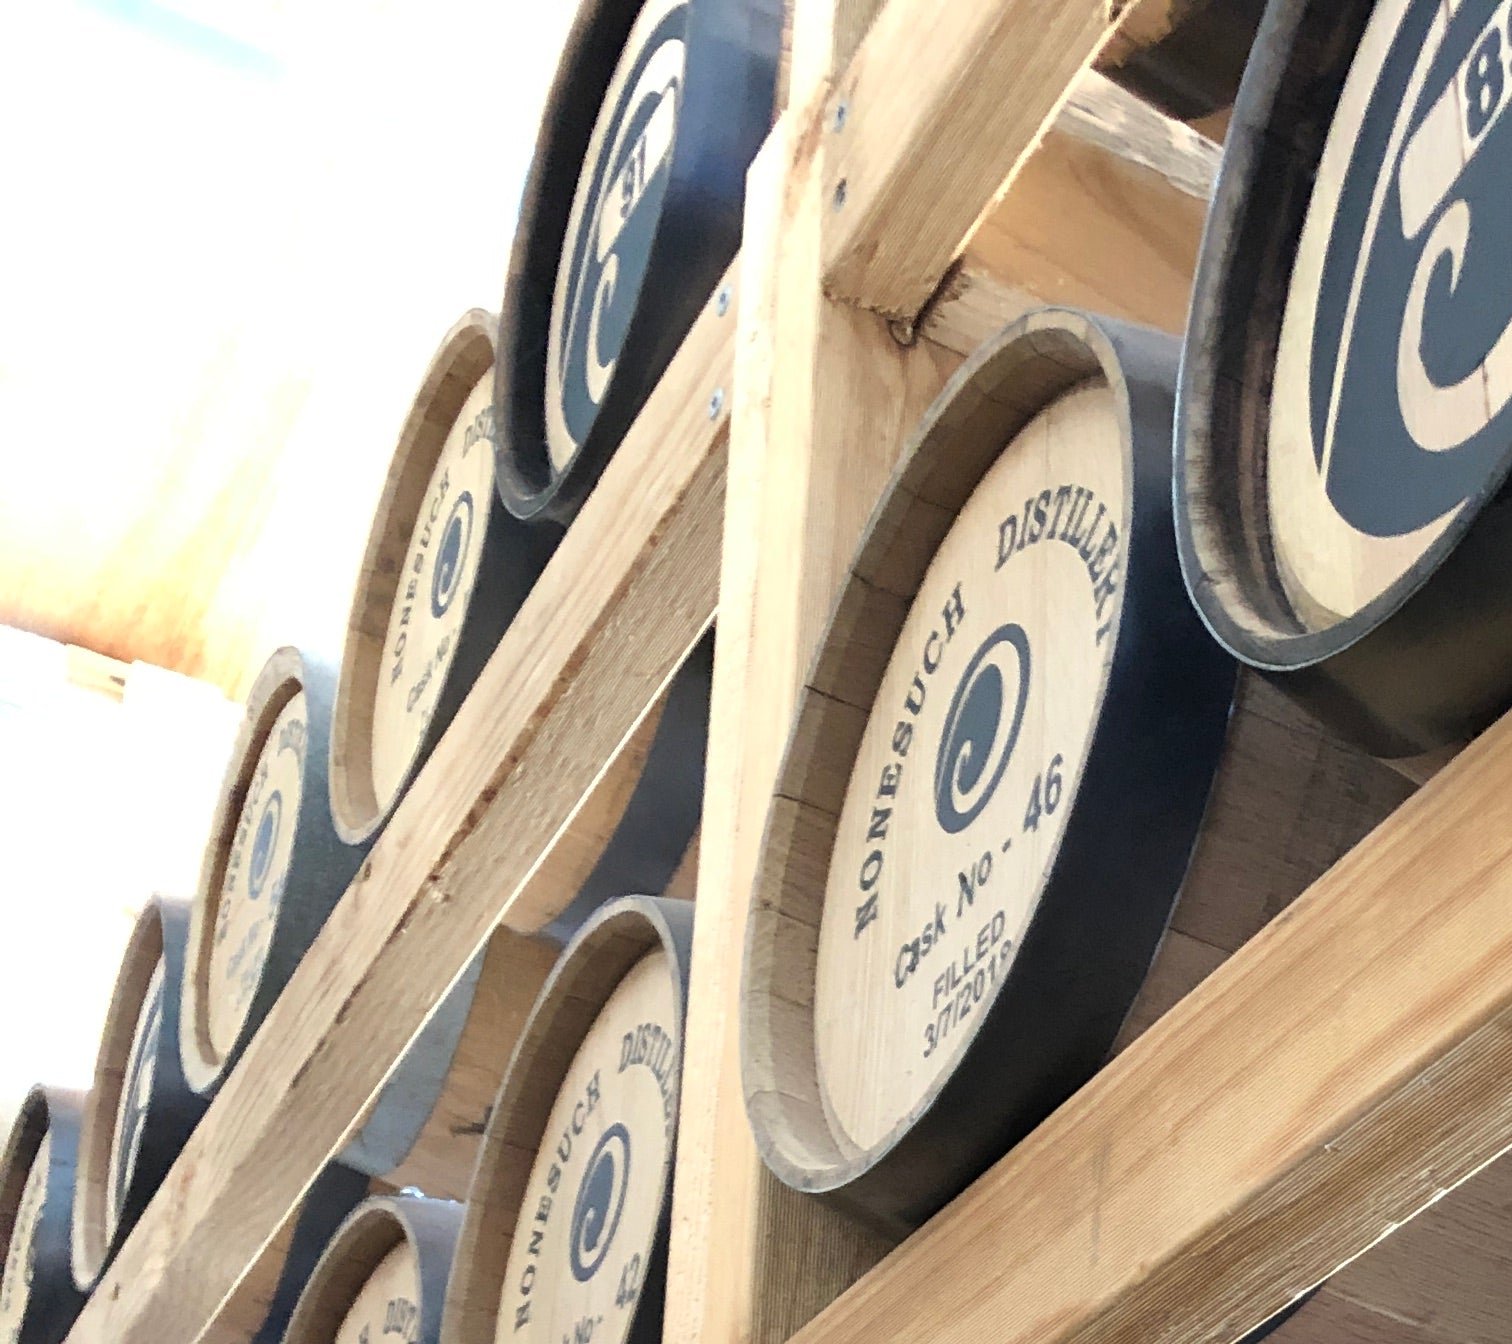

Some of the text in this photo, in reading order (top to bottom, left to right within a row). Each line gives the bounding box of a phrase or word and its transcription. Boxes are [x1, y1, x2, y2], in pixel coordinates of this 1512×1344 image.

[855, 581, 966, 940] NONESUCH
[895, 902, 946, 987] Cask
[1023, 753, 1063, 832] 46
[933, 910, 1005, 1010] FILLED
[514, 1069, 601, 1333] NONESUCH
[615, 1253, 641, 1309] 42
